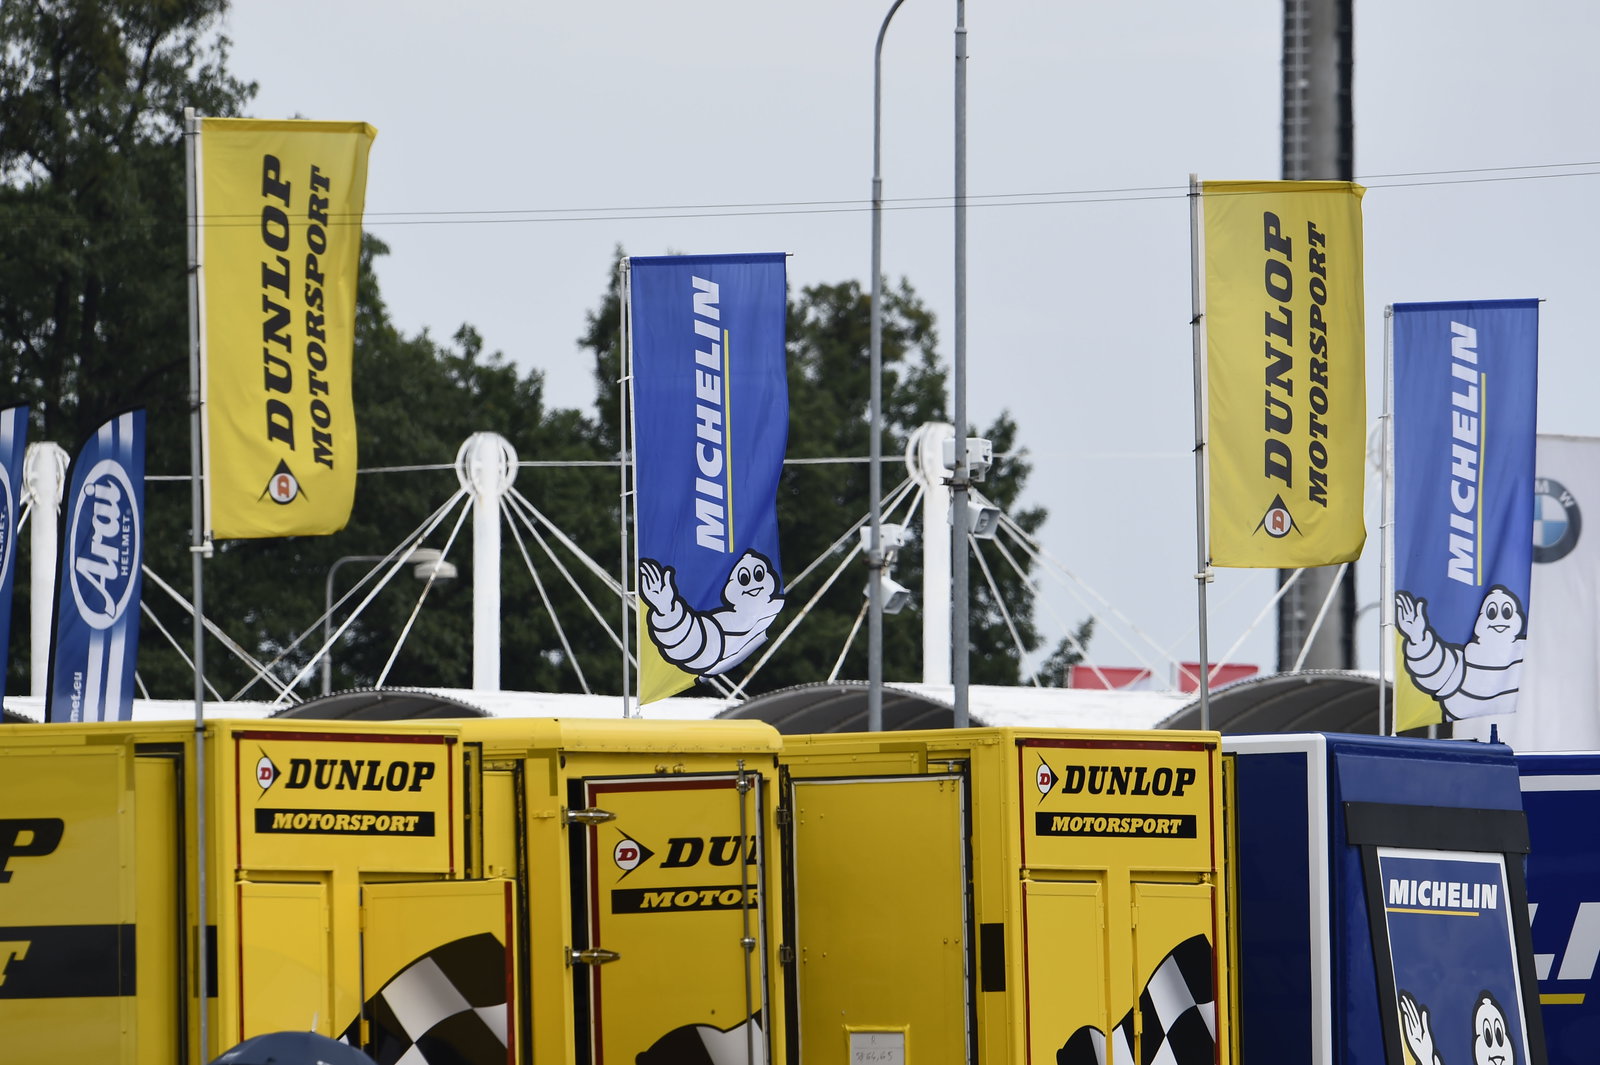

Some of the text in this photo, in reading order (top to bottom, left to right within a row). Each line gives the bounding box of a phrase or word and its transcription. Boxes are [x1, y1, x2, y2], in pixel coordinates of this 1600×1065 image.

[261, 153, 295, 452] DUNLOP
[305, 164, 333, 470] MOTORSPORT
[1263, 211, 1293, 489] DUNLOP
[1307, 220, 1329, 508] MOTORSPORT
[692, 275, 725, 553] MICHELIN
[1448, 321, 1478, 586] MICHELIN
[75, 479, 122, 619] Arai
[121, 514, 131, 577] HELMET
[272, 812, 419, 833] MOTORSPORT
[285, 758, 435, 792] DUNLOP
[1051, 816, 1182, 835] MOTORSPORT
[1062, 765, 1196, 797] DUNLOP
[1388, 878, 1498, 910] MICHELIN
